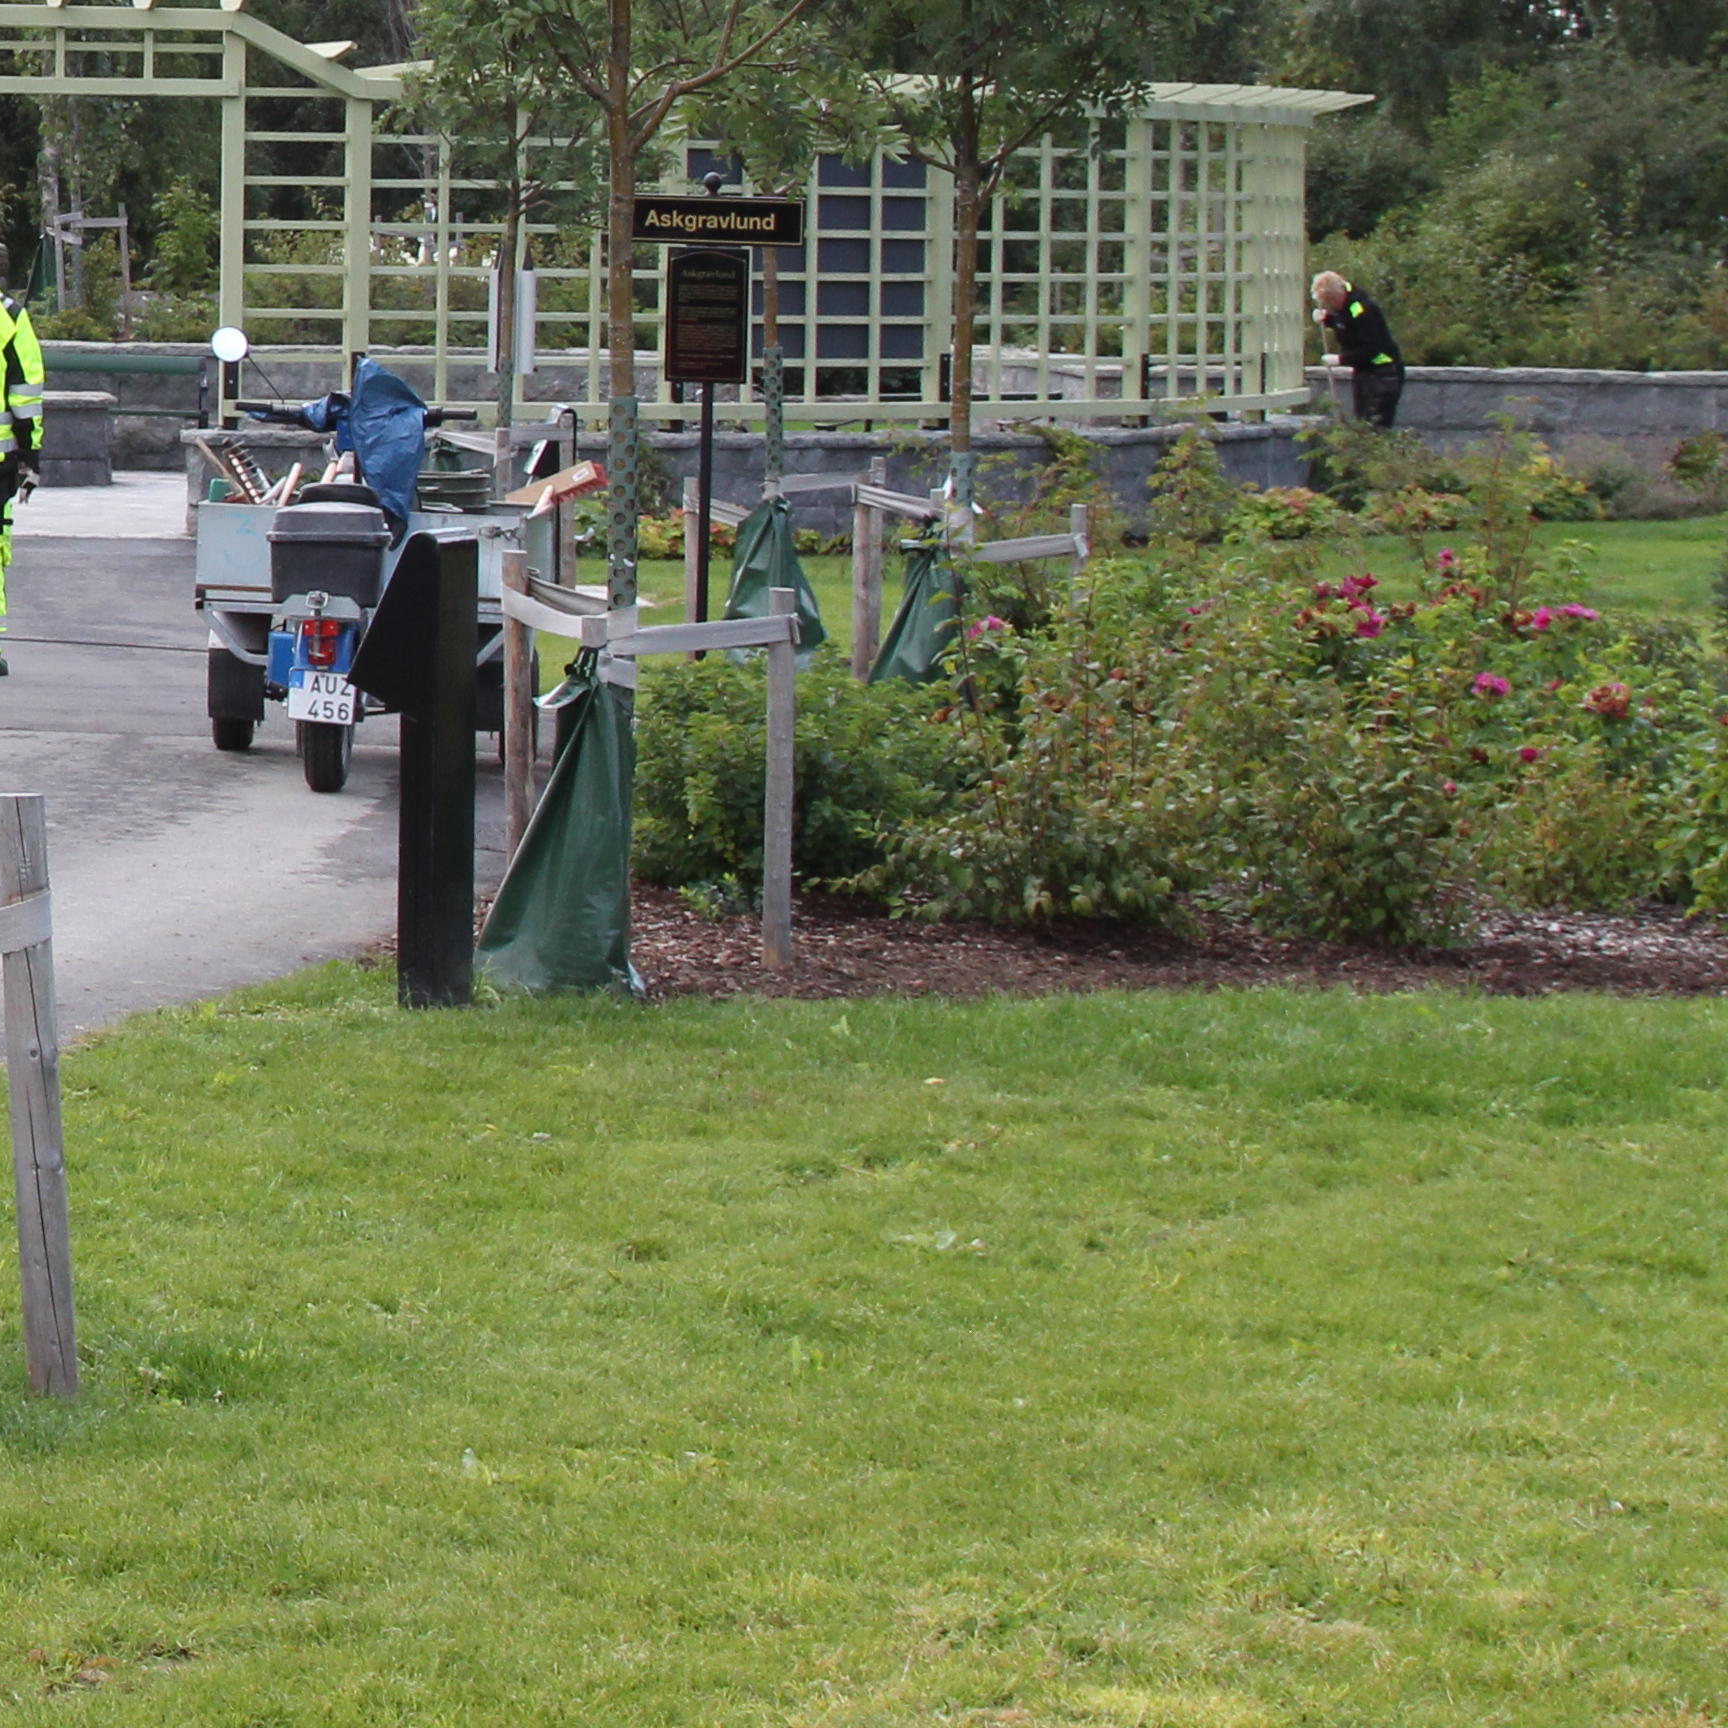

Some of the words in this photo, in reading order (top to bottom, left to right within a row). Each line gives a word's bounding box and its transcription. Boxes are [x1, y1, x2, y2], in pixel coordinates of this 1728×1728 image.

[645, 209, 776, 232] Askgravlund
[310, 675, 351, 696] AUZ
[307, 700, 349, 721] 456
